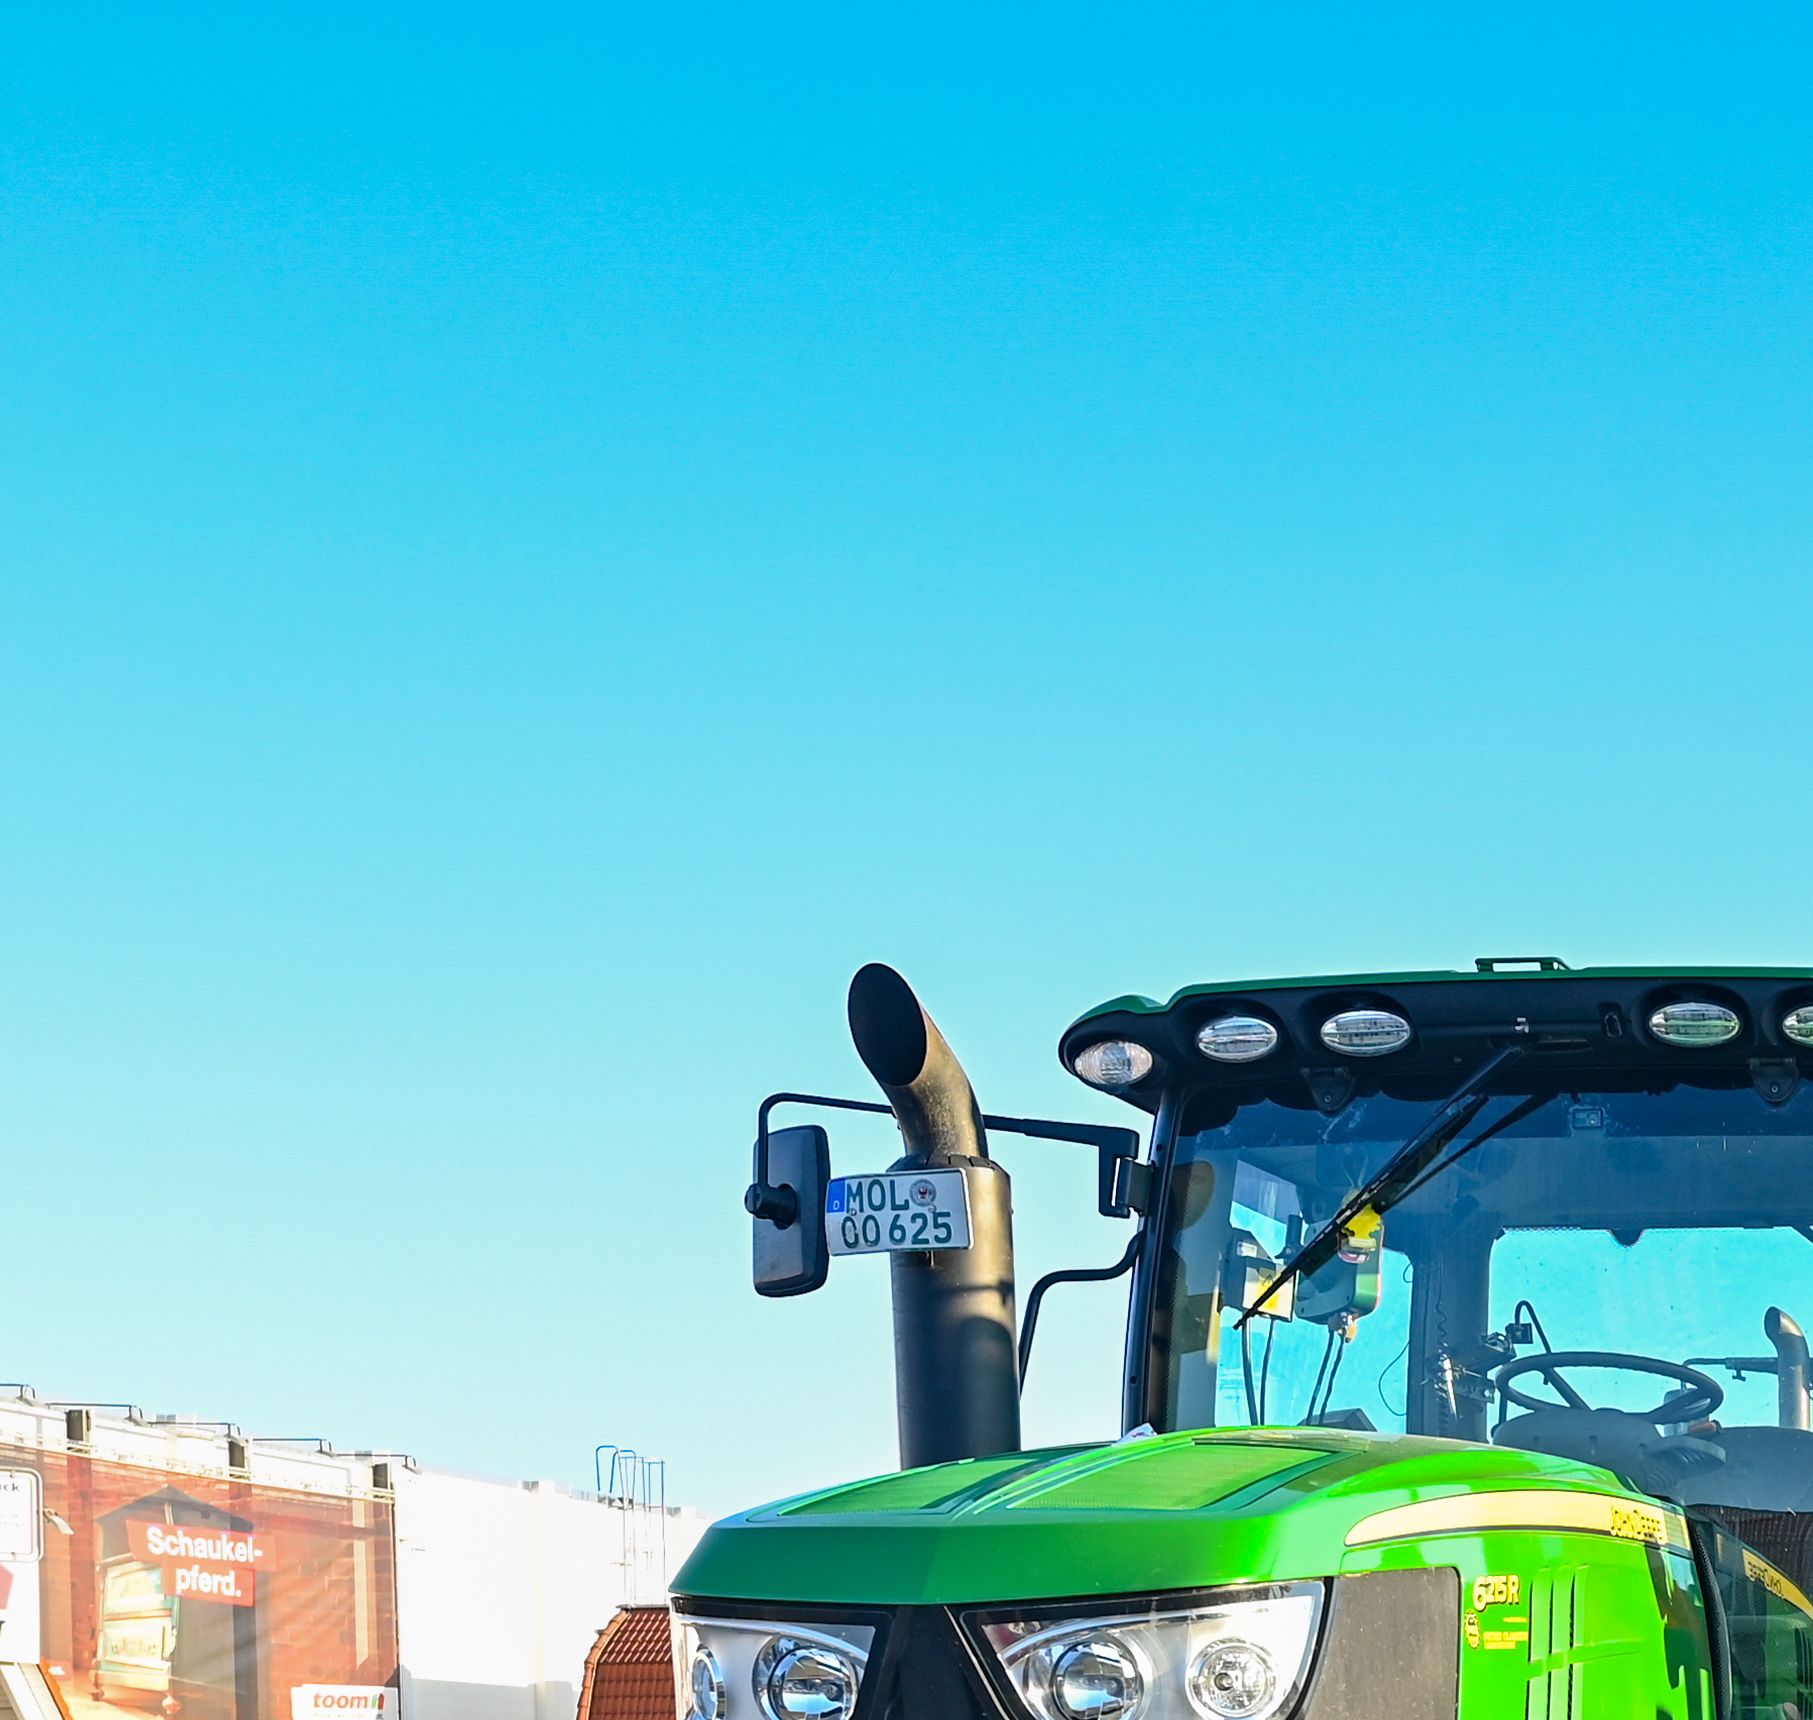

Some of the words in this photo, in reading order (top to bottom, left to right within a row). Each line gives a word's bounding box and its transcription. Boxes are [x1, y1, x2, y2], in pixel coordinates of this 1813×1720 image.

[846, 1179, 910, 1213] MOL
[888, 1211, 952, 1246] 625
[147, 1526, 263, 1563] Schaukel-
[175, 1565, 242, 1598] pferd.
[313, 1692, 369, 1710] toom
